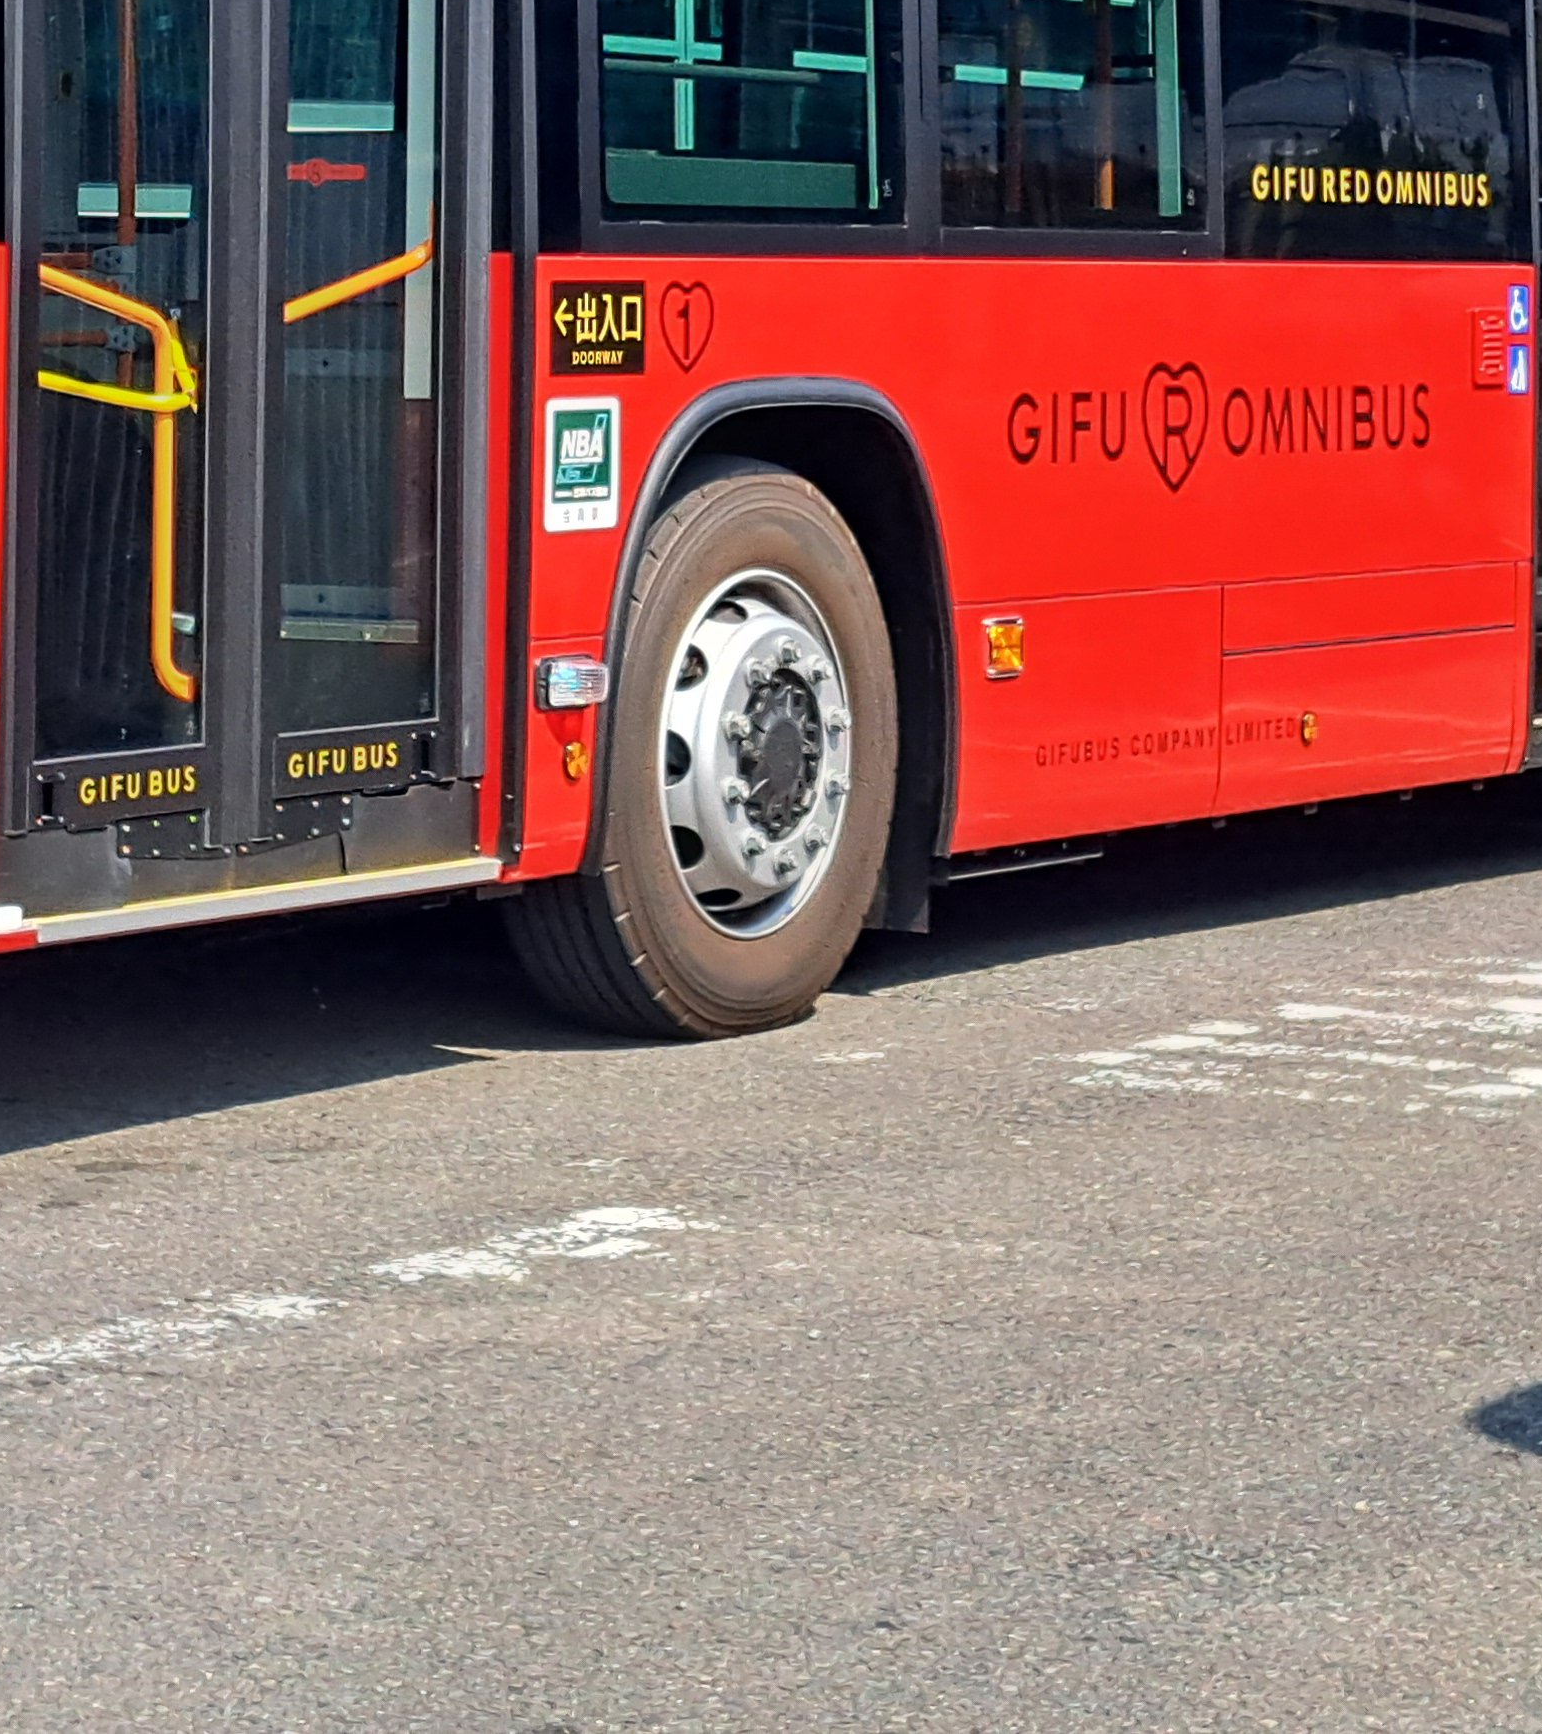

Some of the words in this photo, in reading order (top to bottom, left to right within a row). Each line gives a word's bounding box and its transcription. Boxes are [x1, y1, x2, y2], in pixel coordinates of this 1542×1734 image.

[1251, 163, 1315, 203] GIFU
[1321, 166, 1371, 204] RED
[1375, 169, 1492, 208] OMNIBUS
[575, 291, 644, 345] 出入口
[571, 349, 625, 366] DOORWAY
[561, 429, 606, 460] NBA
[1006, 389, 1128, 466] GIFU
[1220, 383, 1432, 459] OMNIBUS
[286, 747, 348, 780] GIFU
[351, 741, 400, 773] BUS
[1035, 735, 1121, 768] GIFUBUS
[1130, 725, 1218, 758] COMPANY
[1225, 715, 1298, 747] LIMITED
[78, 772, 143, 806] GIFU
[147, 765, 197, 797] BUS
